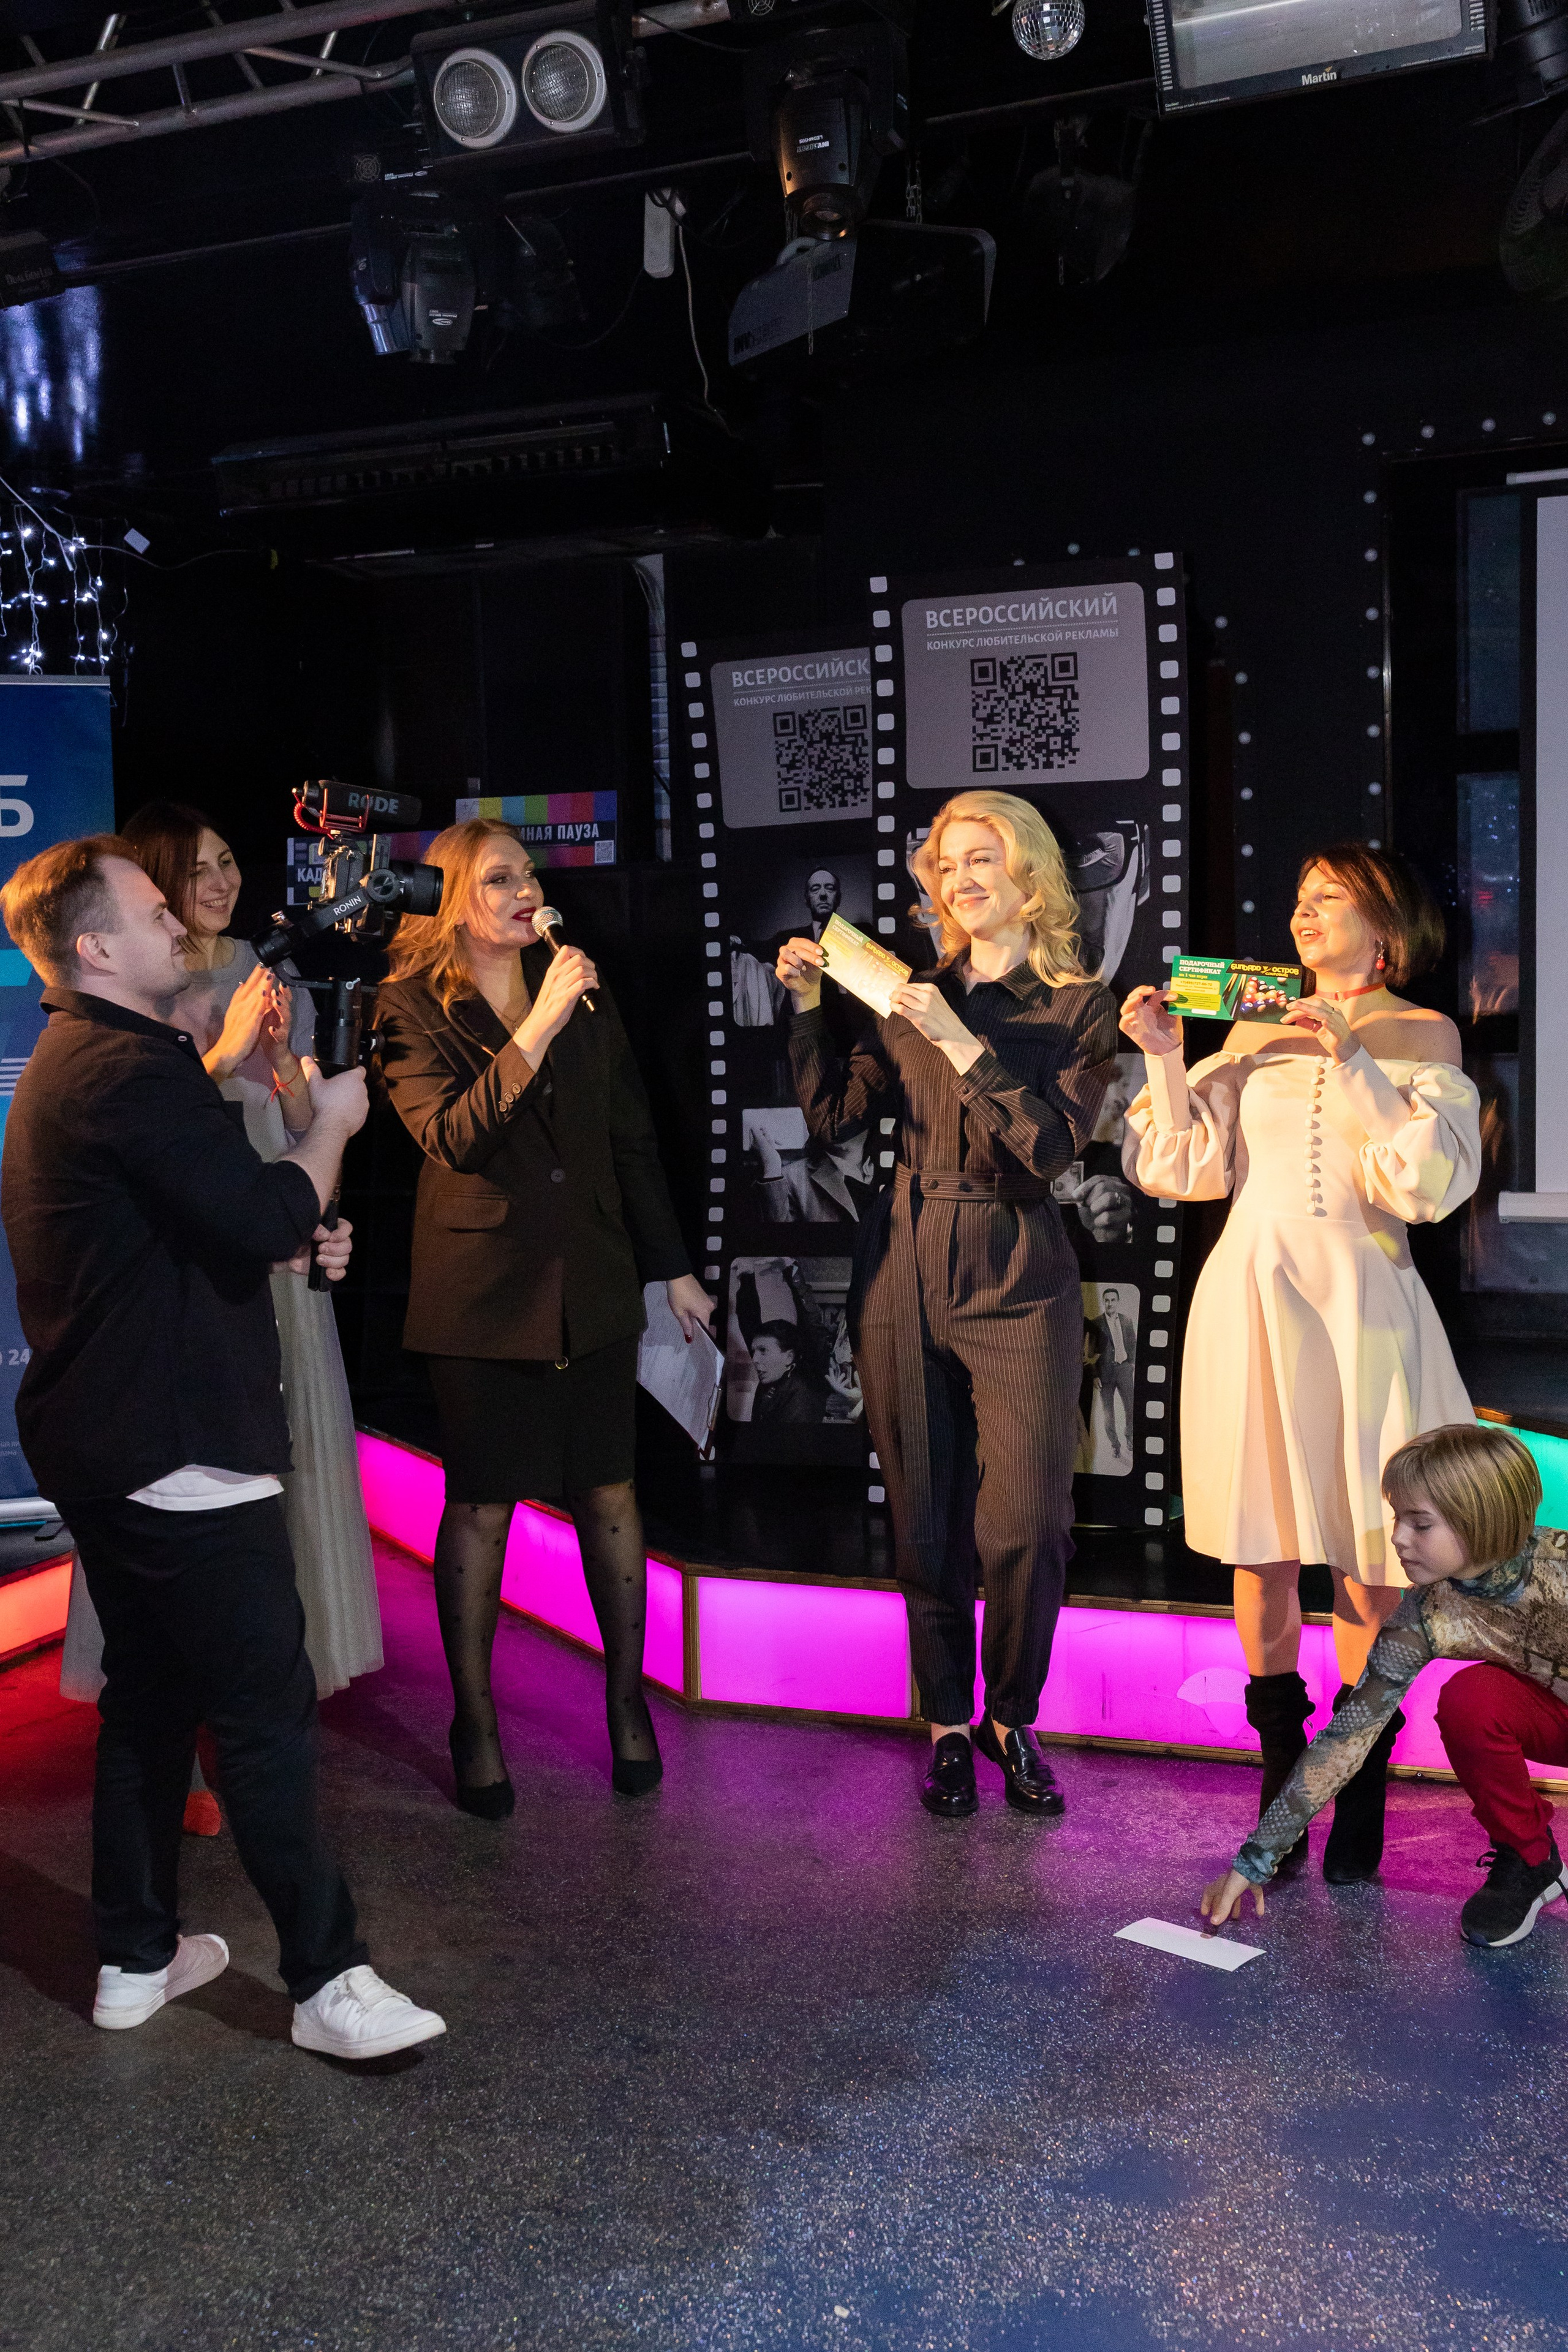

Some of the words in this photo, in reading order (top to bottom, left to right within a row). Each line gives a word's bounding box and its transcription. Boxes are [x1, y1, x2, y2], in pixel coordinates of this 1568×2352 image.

[1301, 68, 1337, 86] Martin
[925, 592, 1118, 629] ВСЕРОССИЙСКИЙ
[926, 638, 975, 650] КОНКУРС
[976, 629, 1063, 647] ЛЮБИТЕЛЬСКОЙ
[1065, 628, 1119, 640] РЕКЛАМЫ
[731, 657, 870, 687] ВСЕРОССИЙСК
[733, 695, 776, 707] КОНКУРС
[777, 685, 853, 703] ЛЮБИТЕЛЬСКОЙ
[854, 685, 872, 695] РЕК
[557, 823, 600, 842] ПАУЗА
[297, 867, 323, 884] КАД
[333, 895, 363, 916] RONIN
[832, 924, 859, 947] СЕРТИФИКАТ
[834, 919, 864, 943] ПОДАРОЧНЫЙ
[1178, 967, 1221, 975] СЕРТИФИКАТ
[1180, 959, 1225, 969] ПОДАРОЧНЫЙ
